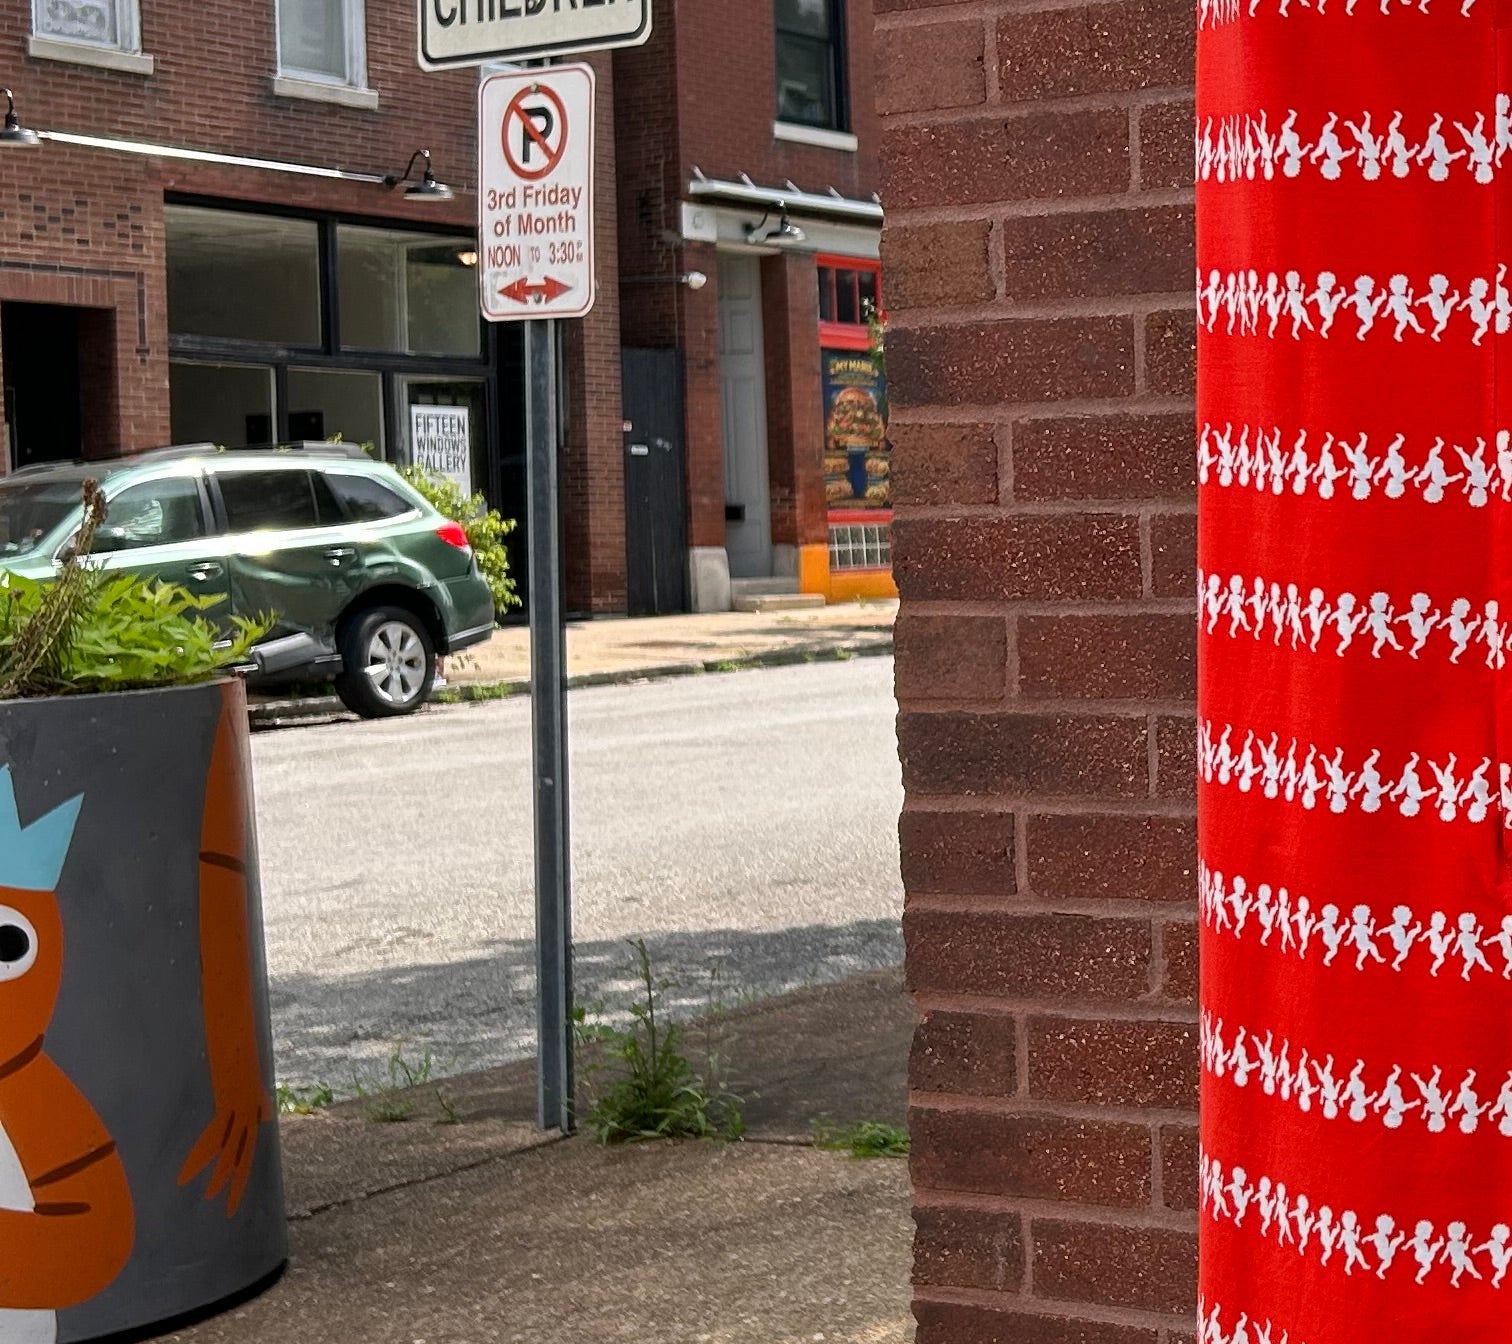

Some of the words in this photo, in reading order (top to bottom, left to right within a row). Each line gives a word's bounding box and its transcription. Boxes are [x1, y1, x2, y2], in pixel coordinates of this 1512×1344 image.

[487, 186, 516, 211] 3rd
[523, 182, 582, 210] Friday
[494, 214, 511, 237] of
[517, 210, 576, 236] Month
[488, 244, 521, 269] NOON
[530, 245, 541, 263] TO
[549, 241, 574, 265] 3:30
[415, 413, 466, 435] FIFTEEN
[416, 436, 467, 454] WINDOWS
[417, 454, 467, 474] GALLERY
